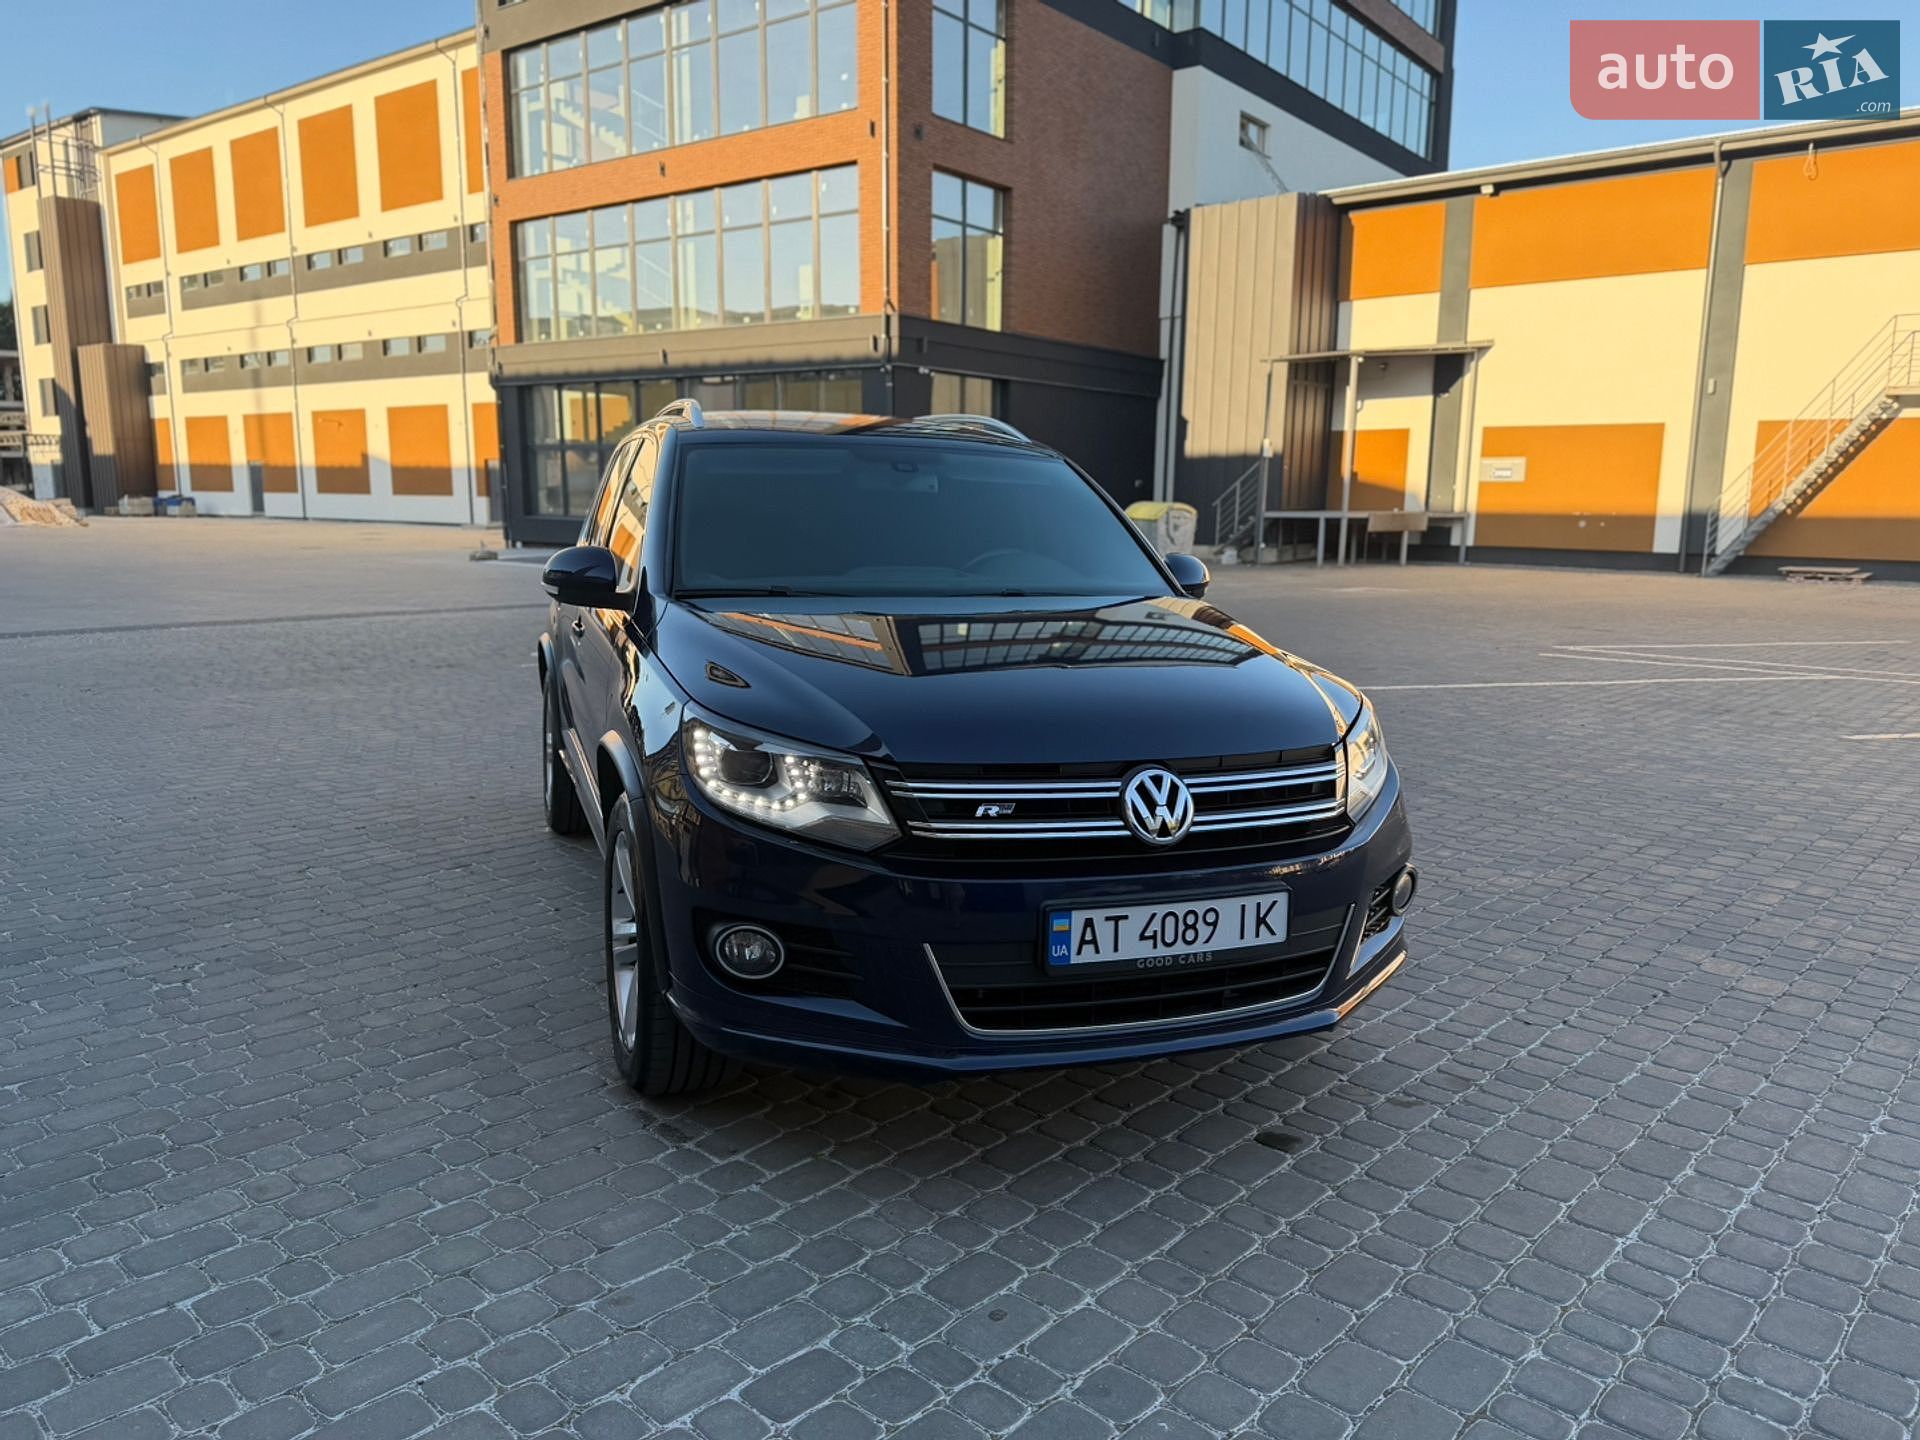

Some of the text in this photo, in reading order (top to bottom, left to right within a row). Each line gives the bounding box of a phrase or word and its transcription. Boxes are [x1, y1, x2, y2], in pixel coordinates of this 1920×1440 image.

[1127, 770, 1190, 842] VW
[1076, 900, 1279, 956] AT 4089 IK
[1051, 945, 1069, 957] UA
[1136, 952, 1213, 969] GOOD CARS
